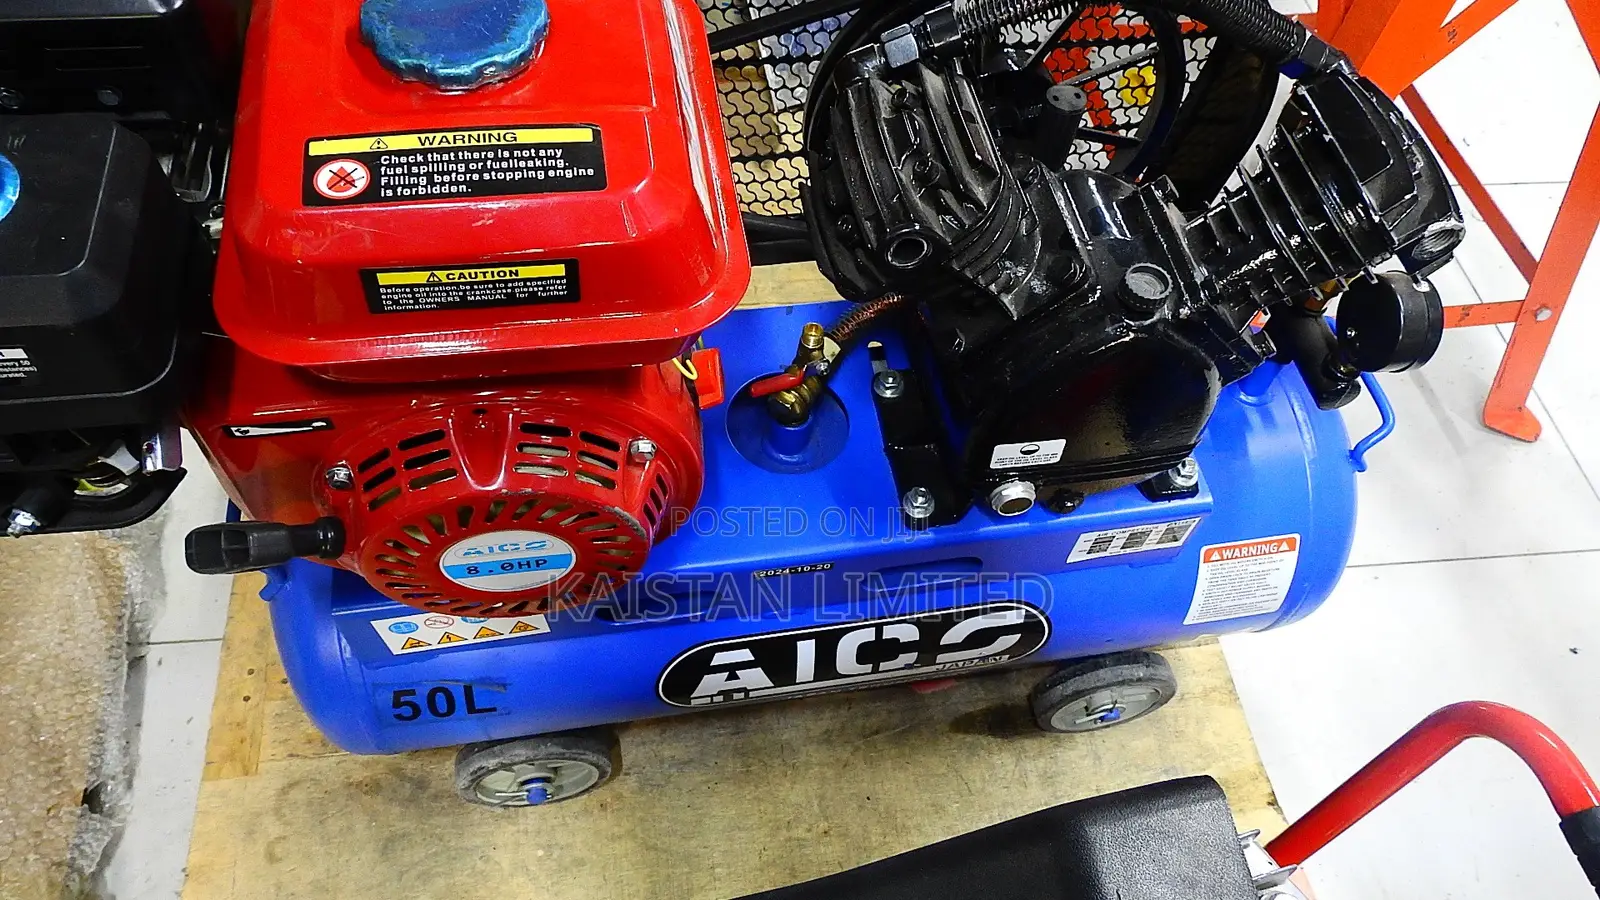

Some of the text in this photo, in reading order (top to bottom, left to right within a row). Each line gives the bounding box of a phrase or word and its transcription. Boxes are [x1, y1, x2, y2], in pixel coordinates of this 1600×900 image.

[418, 132, 518, 147] WARNING
[380, 148, 563, 165] Check that there is not any
[380, 164, 408, 175] fuel
[411, 162, 466, 174] spilling
[469, 162, 483, 170] or
[381, 167, 594, 187] Filling before stopping engine
[381, 184, 472, 197] is forbidden.
[446, 269, 519, 281] CAUTION
[526, 278, 567, 287] specified
[418, 296, 460, 304] OWNERS
[538, 290, 568, 298] further
[384, 303, 440, 311] information.
[1221, 542, 1279, 560] WARNING
[466, 558, 549, 576] 8.0HP
[759, 563, 832, 577] 2024-10-20
[391, 684, 498, 722] 50L
